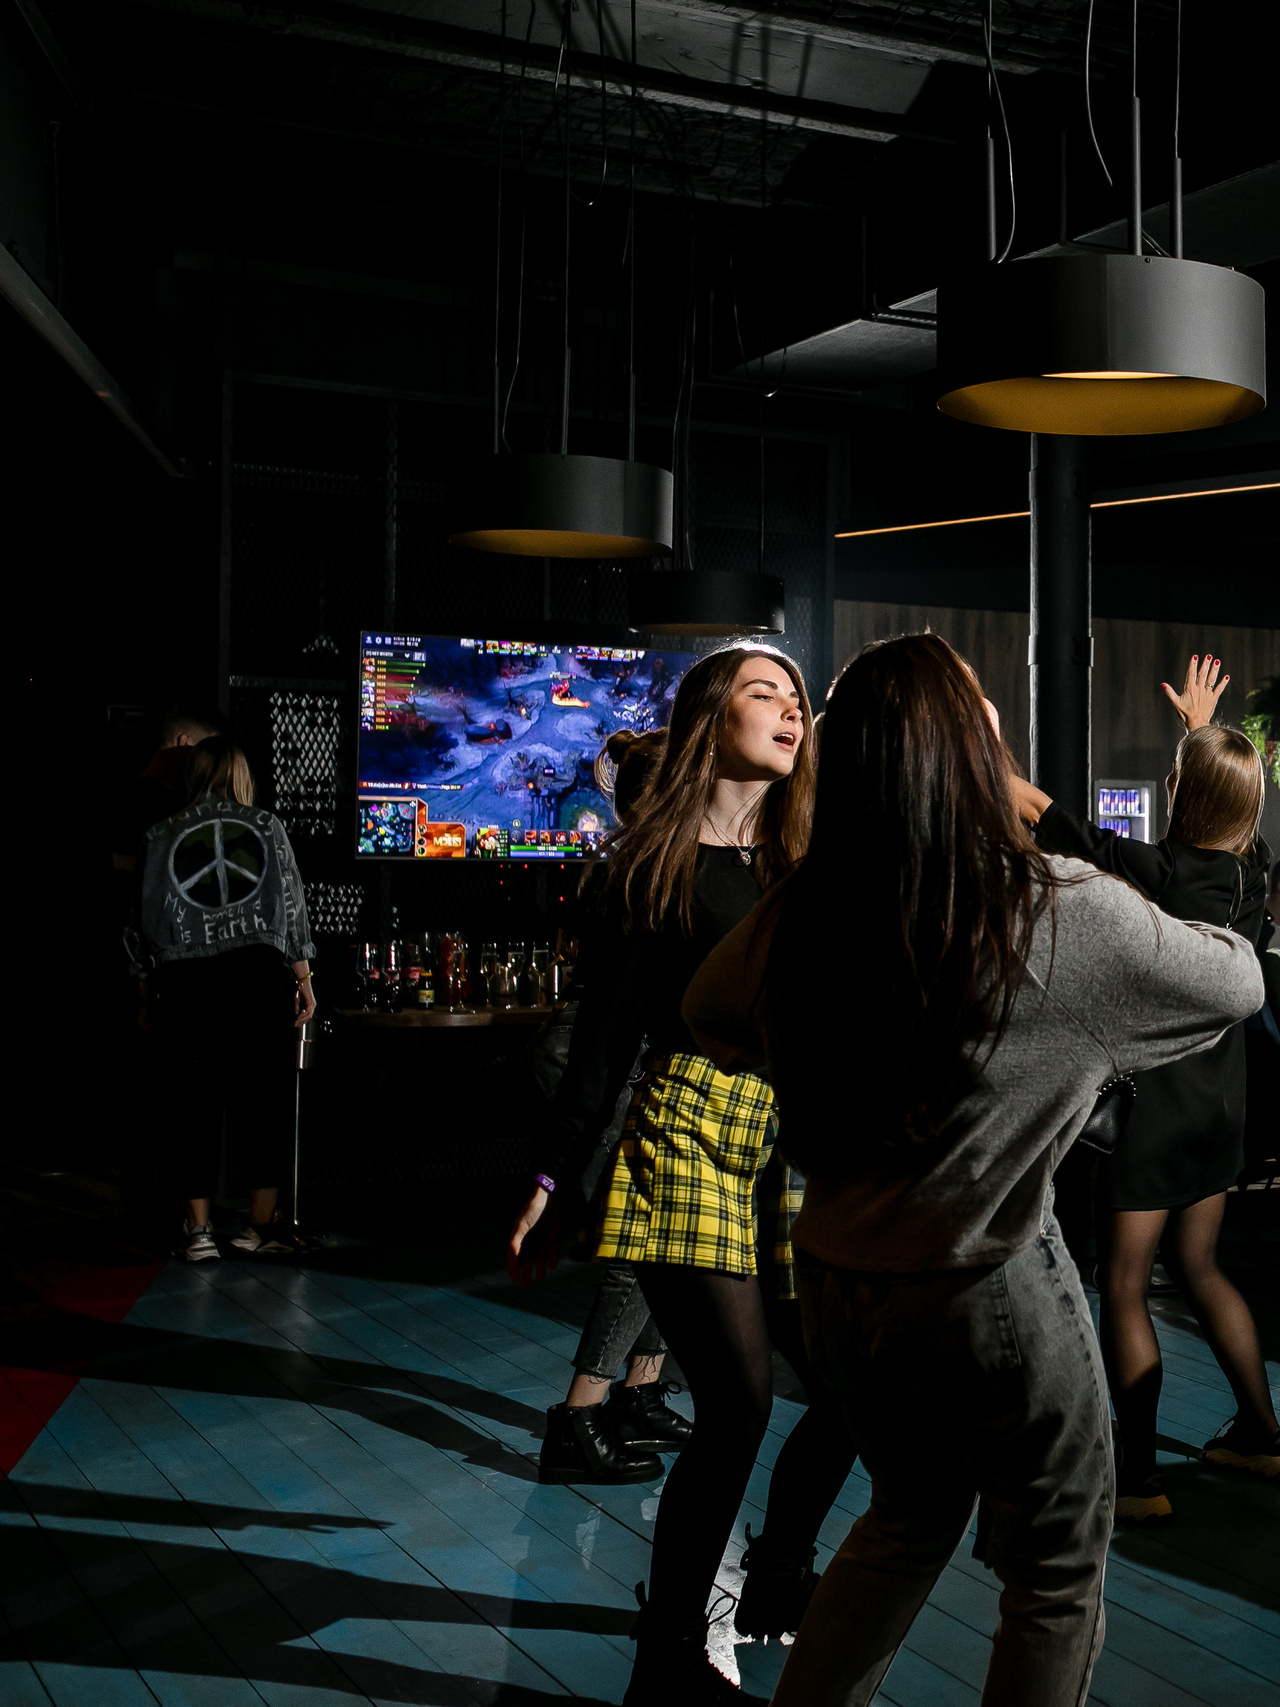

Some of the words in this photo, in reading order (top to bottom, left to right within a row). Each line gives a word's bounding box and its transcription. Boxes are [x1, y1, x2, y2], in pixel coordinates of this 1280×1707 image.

[164, 892, 186, 923] My
[180, 925, 192, 944] is
[204, 914, 268, 945] Earth
